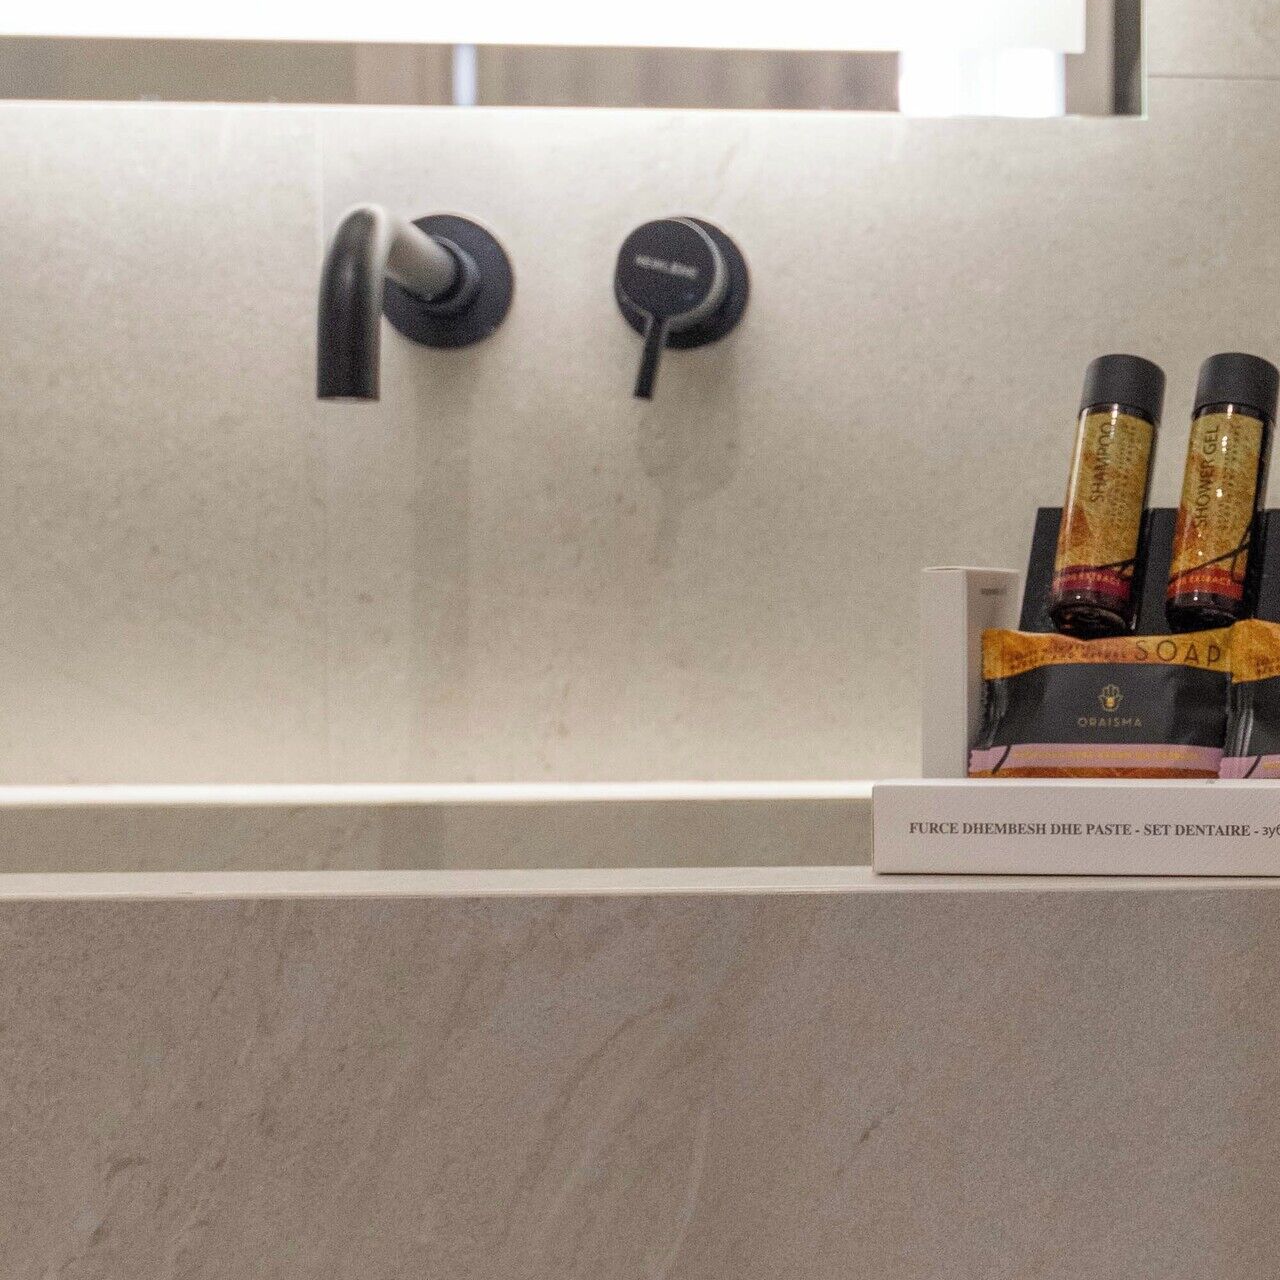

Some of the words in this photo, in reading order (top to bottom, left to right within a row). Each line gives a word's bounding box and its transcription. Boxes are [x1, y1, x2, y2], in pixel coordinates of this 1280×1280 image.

[1203, 424, 1219, 456] GEL
[1089, 421, 1114, 505] SHAMPOO
[1194, 459, 1215, 529] SHOWER
[1134, 639, 1222, 666] SOAP
[1077, 715, 1144, 728] ORAISMA
[909, 822, 959, 835] FURCE
[962, 822, 1047, 836] DHEMBESH
[1050, 823, 1082, 836] DHE
[1086, 823, 1132, 837] PASTE
[1144, 824, 1171, 837] SET
[1175, 824, 1250, 837] DENTAIRE
